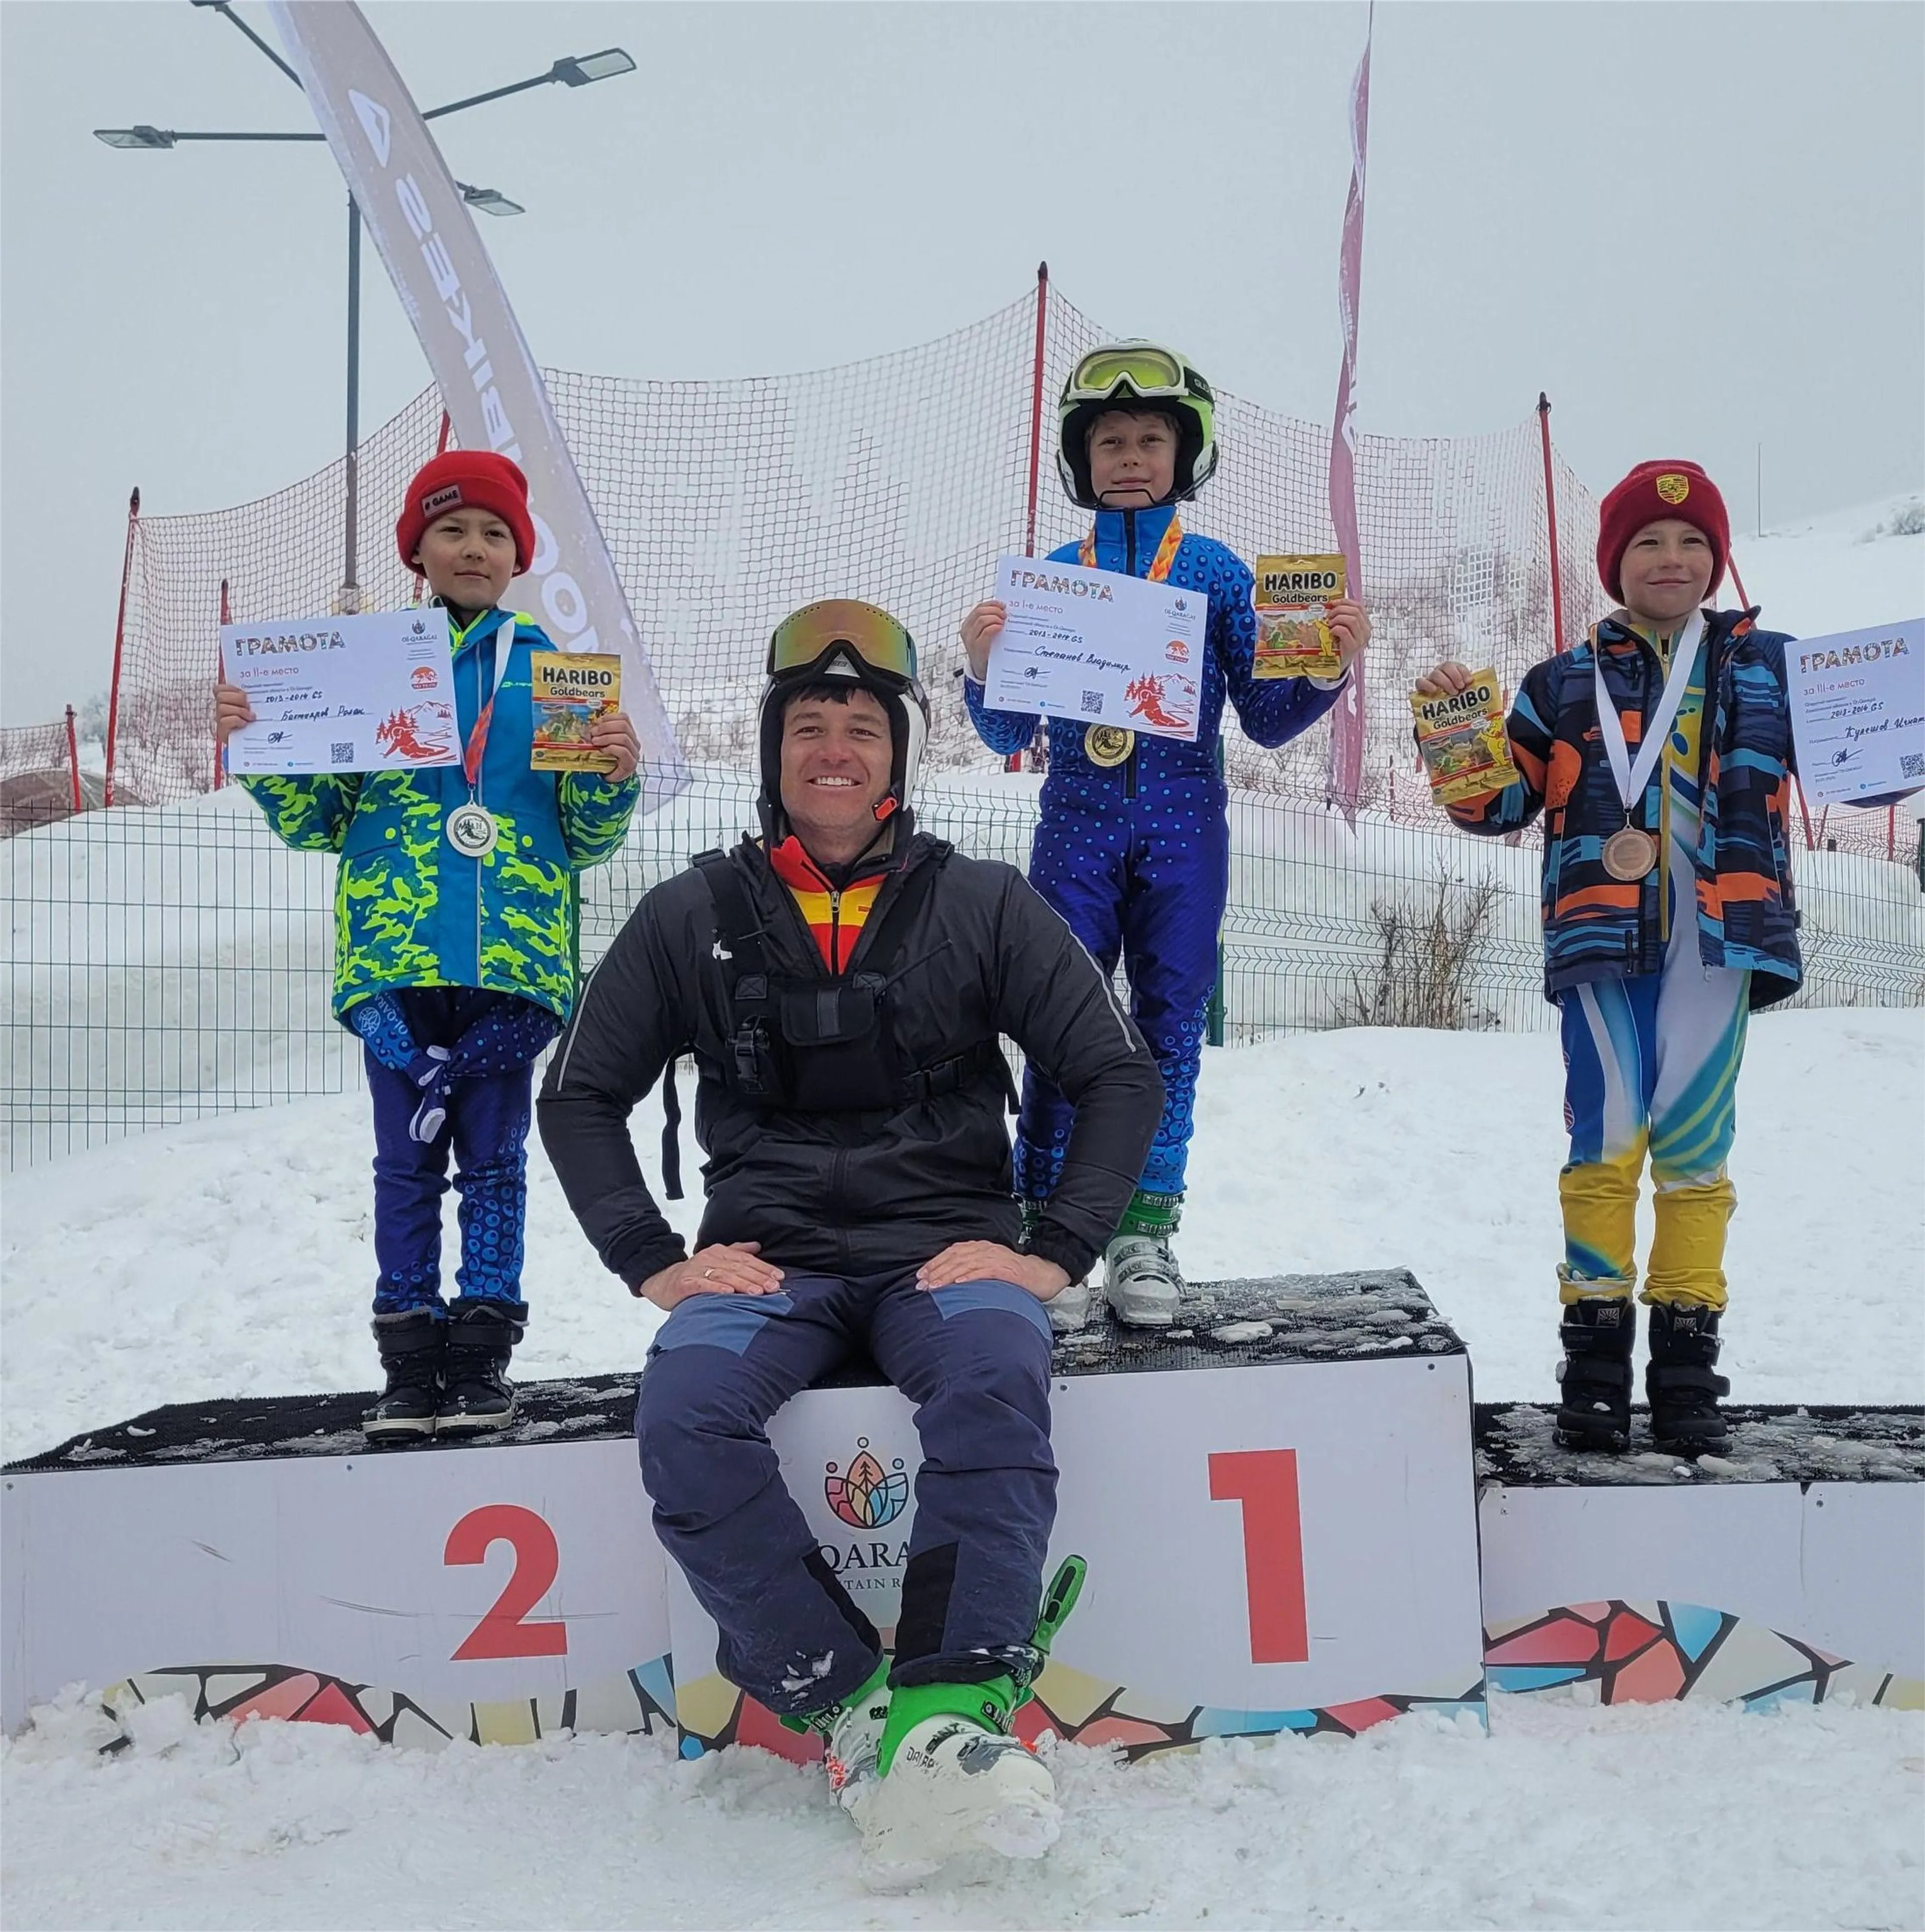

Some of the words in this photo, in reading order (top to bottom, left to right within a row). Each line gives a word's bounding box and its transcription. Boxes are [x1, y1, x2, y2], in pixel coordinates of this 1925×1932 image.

[432, 490, 458, 506] GAME
[1011, 569, 1113, 603] ГРАМОТА
[1265, 572, 1336, 591] HARIBO
[1272, 594, 1328, 603] Goldbears
[1036, 605, 1063, 614] место
[235, 631, 346, 656] ГРАМОТА
[1800, 637, 1909, 673] ГРАМОТА
[240, 670, 251, 678] за
[271, 667, 299, 676] место
[543, 667, 612, 686] HARIBO
[550, 687, 606, 697] Goldbears
[1837, 678, 1865, 690] место
[1422, 686, 1491, 720] HARIBO
[1871, 702, 1883, 711] GS
[1433, 707, 1489, 729] Goldbears
[1208, 1448, 1309, 1664] 1
[444, 1504, 568, 1661] 2
[843, 1579, 885, 1590] TAIN
